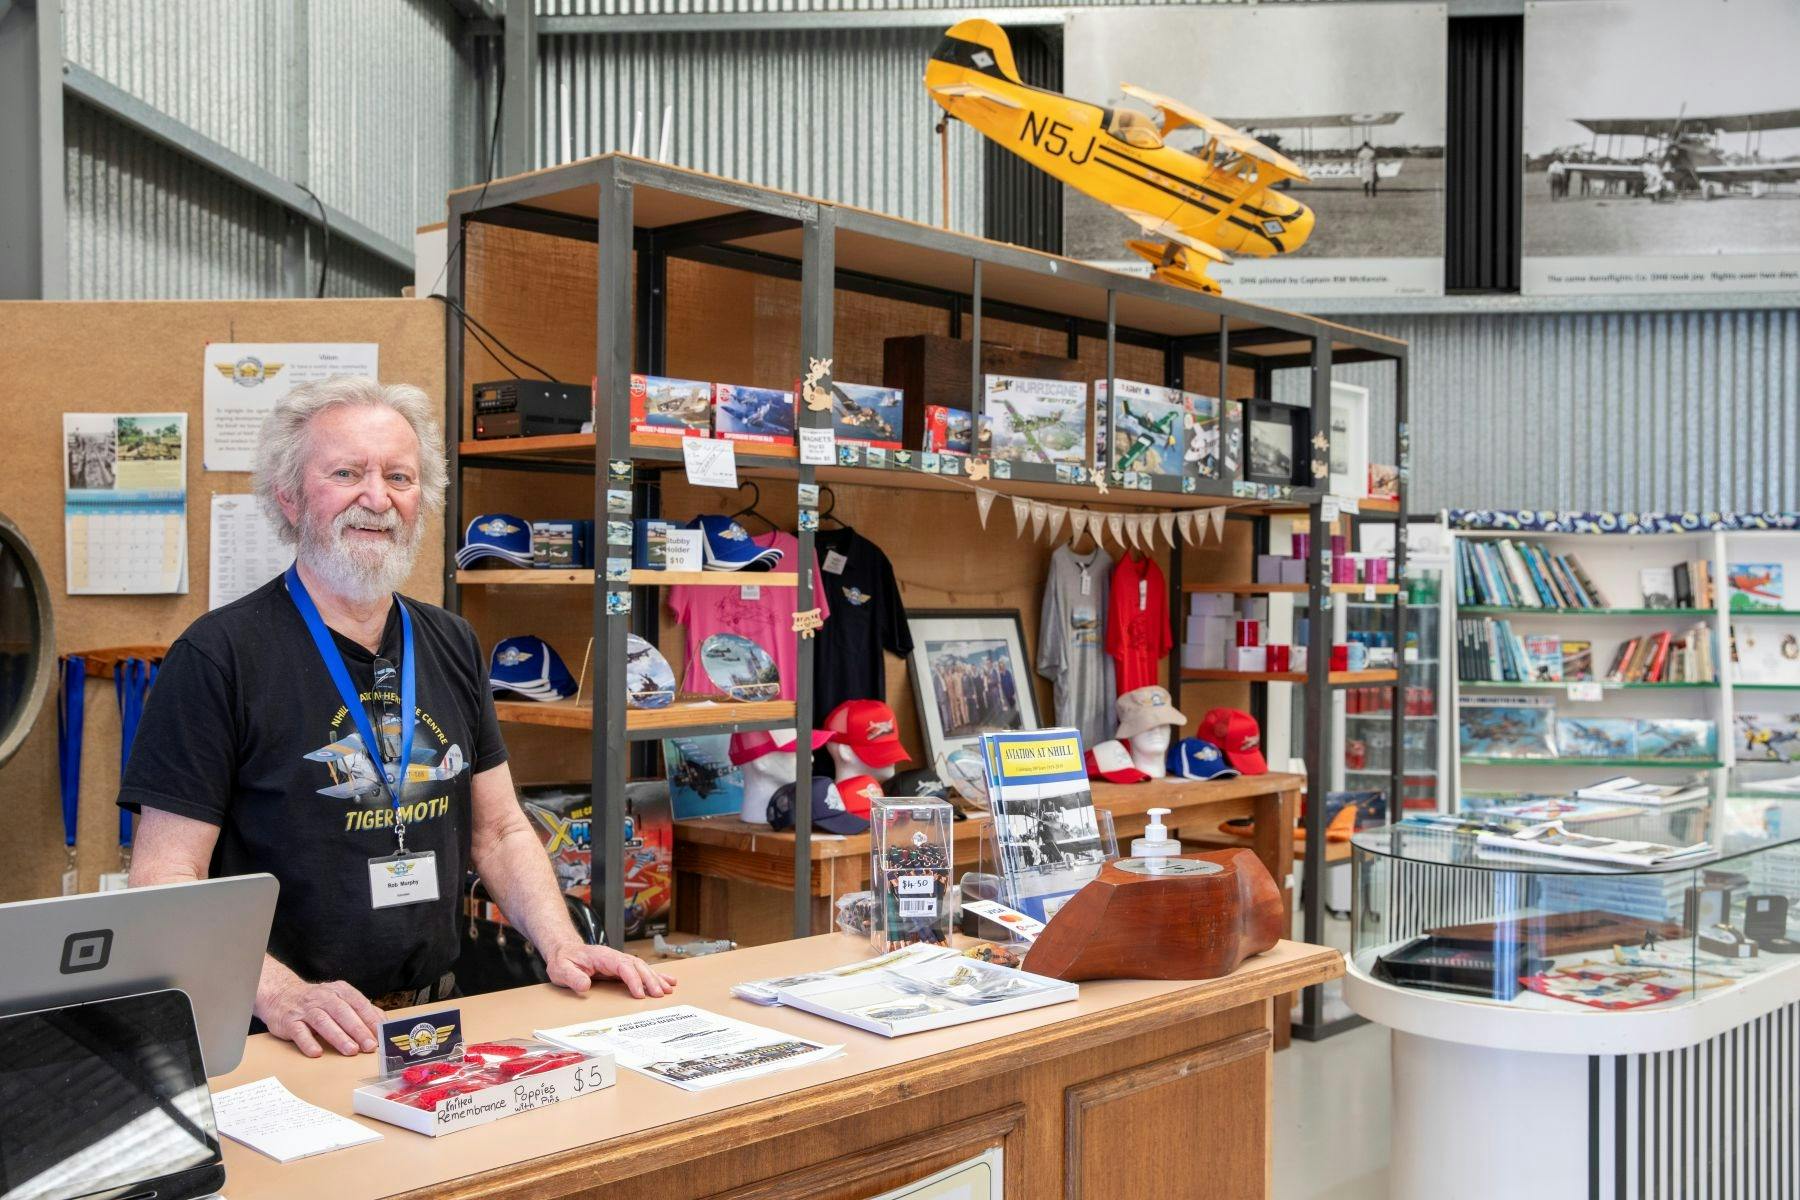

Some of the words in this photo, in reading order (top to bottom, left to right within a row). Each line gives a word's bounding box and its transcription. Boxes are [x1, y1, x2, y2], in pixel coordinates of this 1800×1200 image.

[1020, 111, 1096, 165] N5J
[1289, 277, 1298, 285] by
[1015, 380, 1078, 397] HURRICANE
[422, 713, 448, 745] CENTRE
[1005, 747, 1035, 760] AVIATION
[1037, 747, 1045, 758] AT
[1047, 745, 1073, 758] NHILL
[344, 809, 394, 832] TIGER
[398, 796, 449, 824] MOTH
[657, 1013, 697, 1025] BUILDING
[573, 1065, 602, 1092] $5
[437, 1099, 507, 1124] Remembrance
[513, 1083, 556, 1103] Poppies
[445, 1095, 473, 1112] Knitted
[514, 1102, 534, 1112] with
[541, 1095, 560, 1105] Pins
